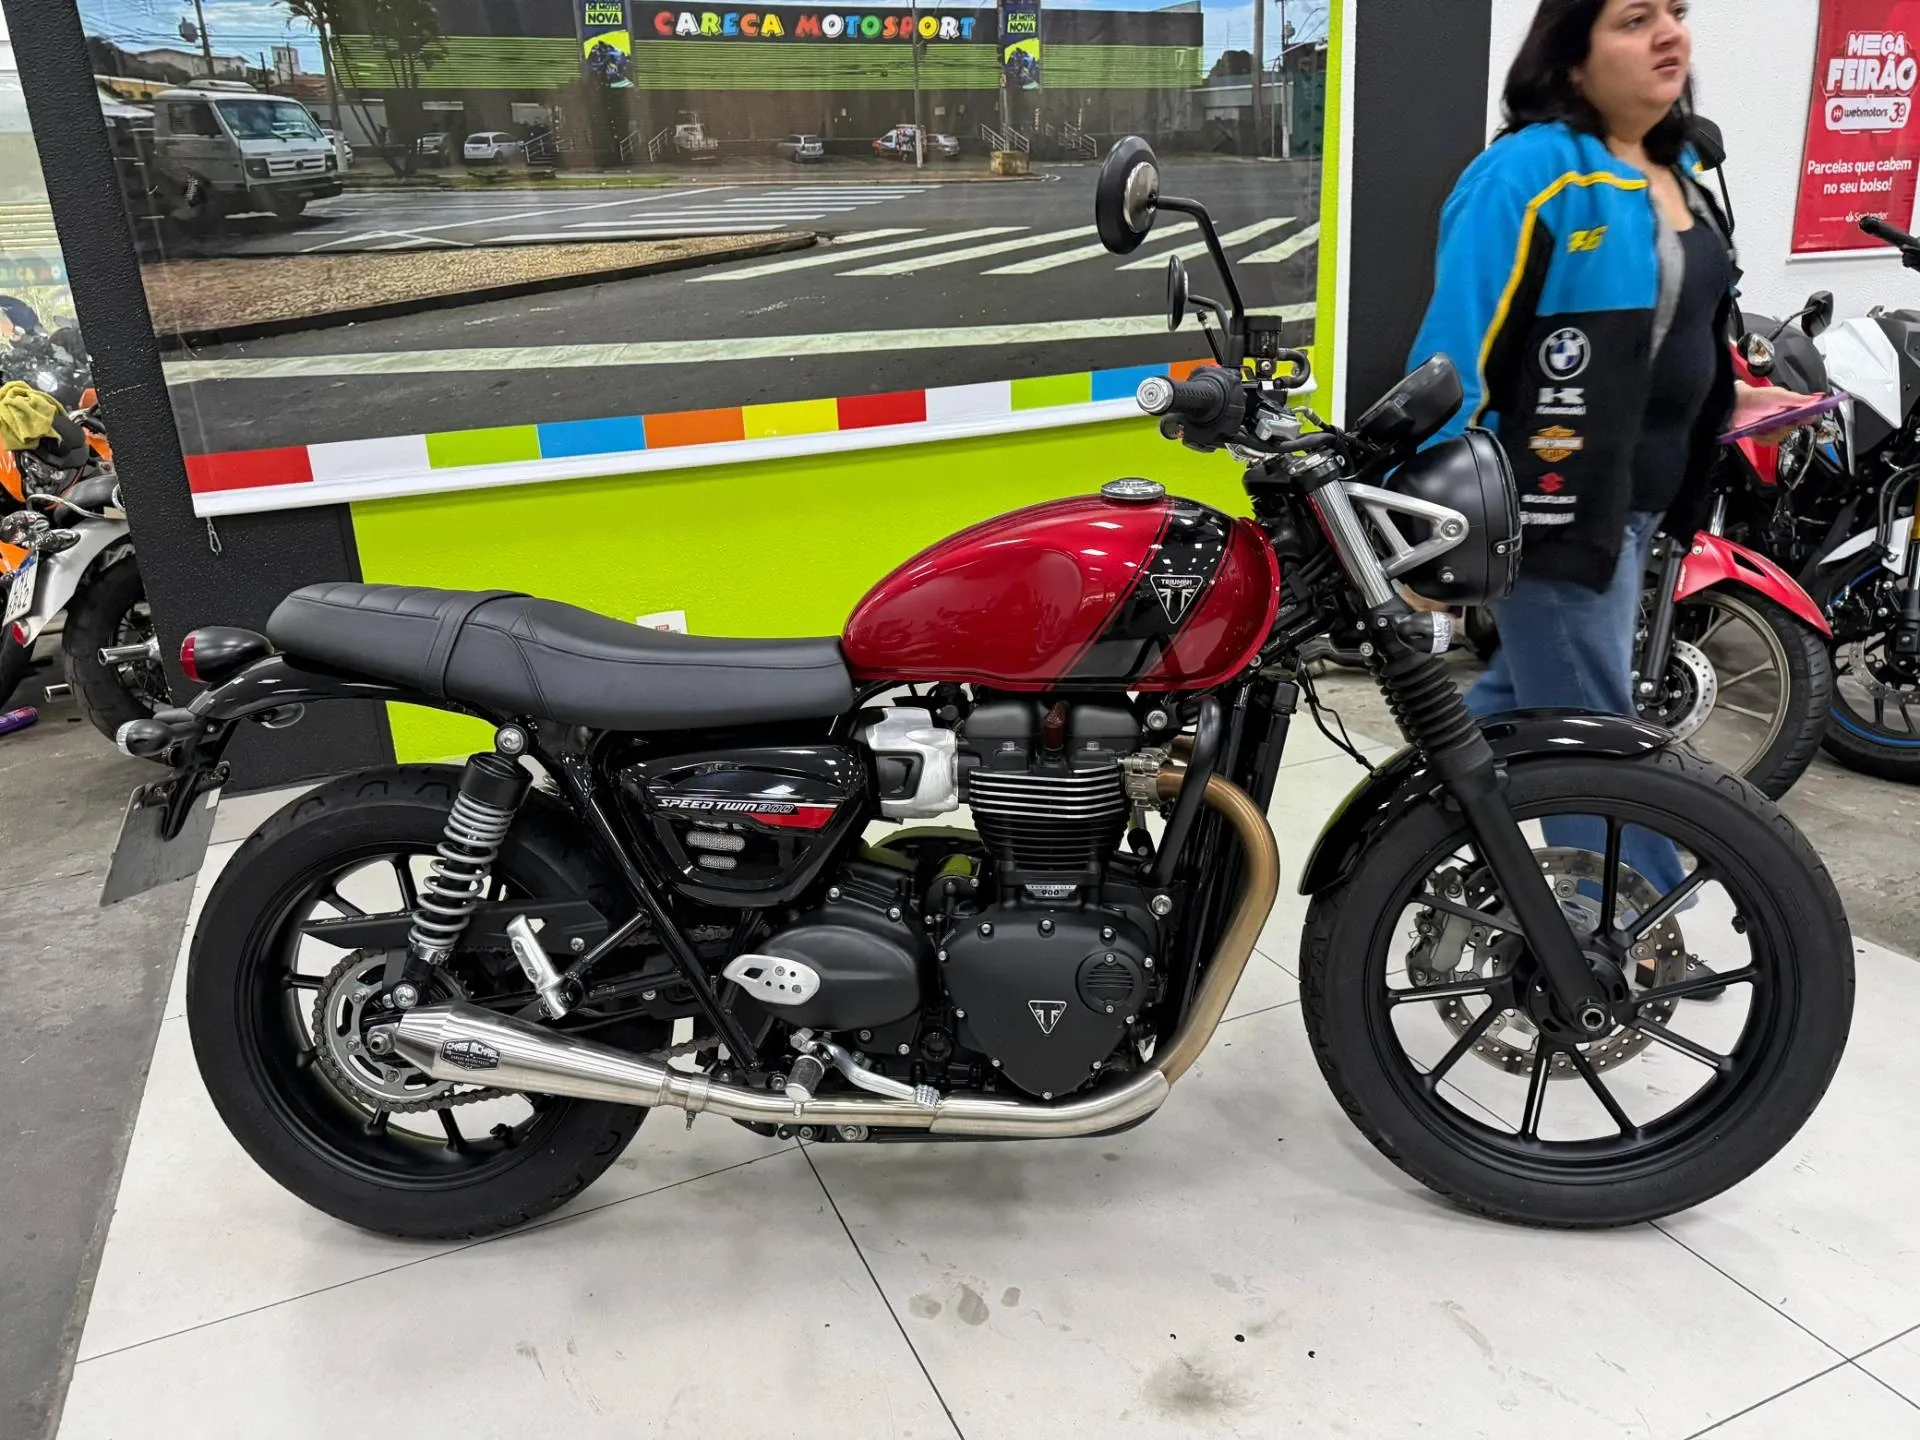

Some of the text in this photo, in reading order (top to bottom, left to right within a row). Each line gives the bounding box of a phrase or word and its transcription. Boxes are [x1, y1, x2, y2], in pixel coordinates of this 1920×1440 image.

[587, 12, 620, 24] NOVA
[654, 11, 977, 40] CARECA MOTOSPORT
[1009, 22, 1034, 33] NOVA
[1847, 33, 1905, 57] MEGA
[1826, 52, 1917, 91] FEIRÃO
[1844, 106, 1888, 118] webmotors
[1807, 156, 1912, 176] Parcelas que cabem
[1823, 177, 1893, 195] no seu bolso!
[1160, 578, 1193, 586] TRIUMPH
[657, 799, 795, 814] SPEED TWIN 900
